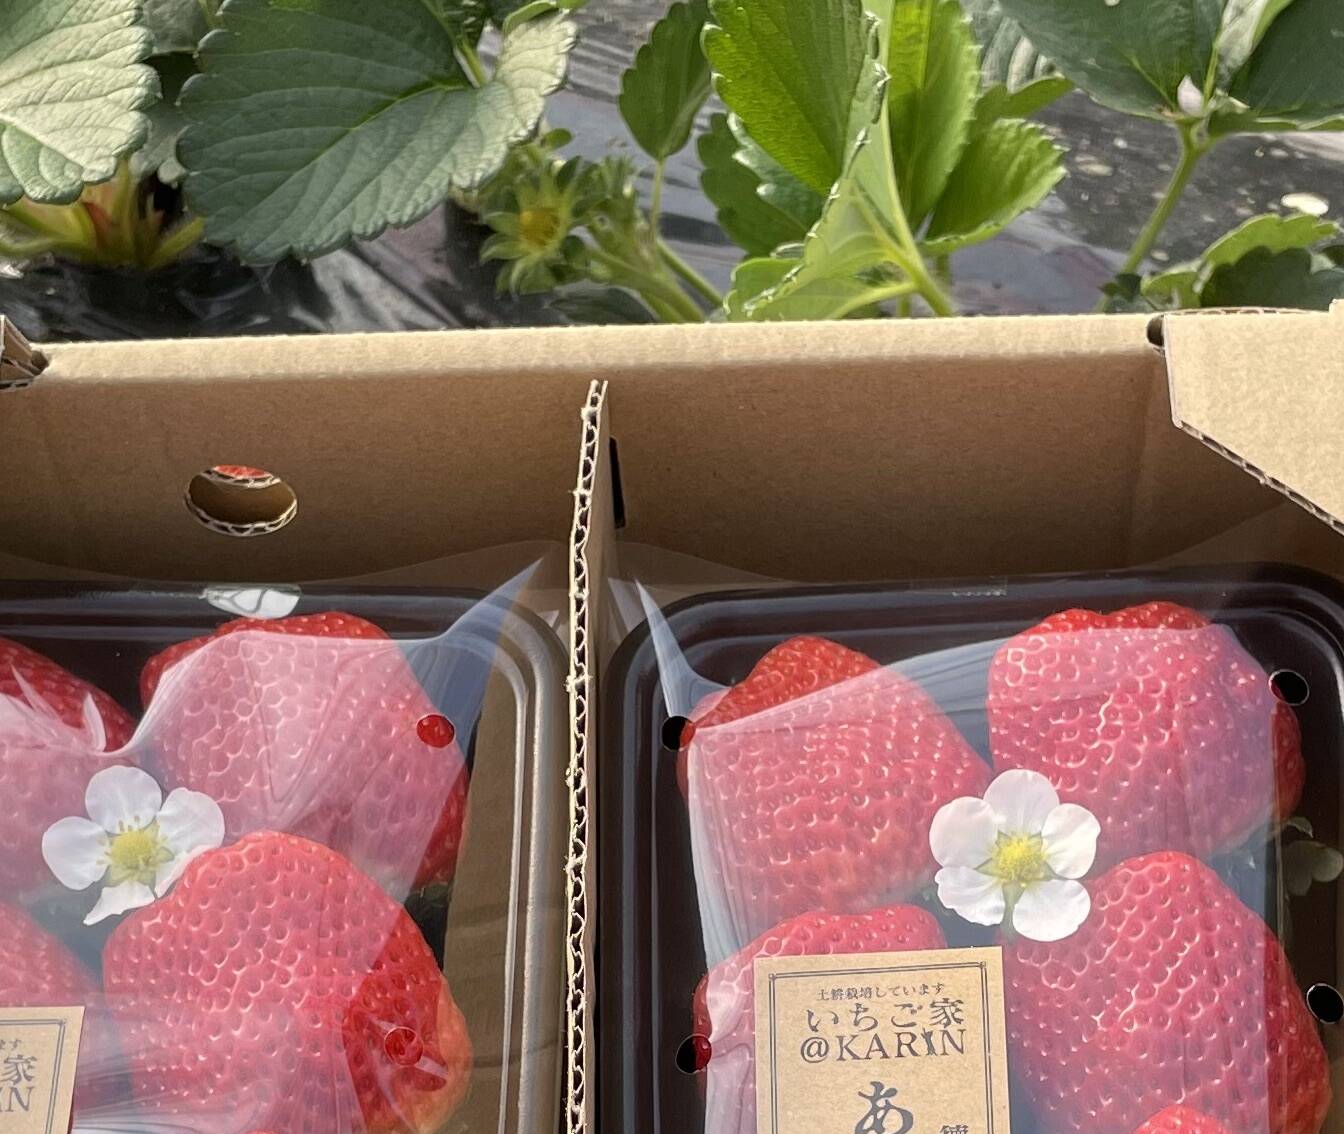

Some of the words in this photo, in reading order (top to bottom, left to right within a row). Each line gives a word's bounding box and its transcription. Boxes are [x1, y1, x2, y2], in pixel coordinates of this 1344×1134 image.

[806, 998, 964, 1033] いちご家
[800, 1027, 967, 1063] @KARIN
